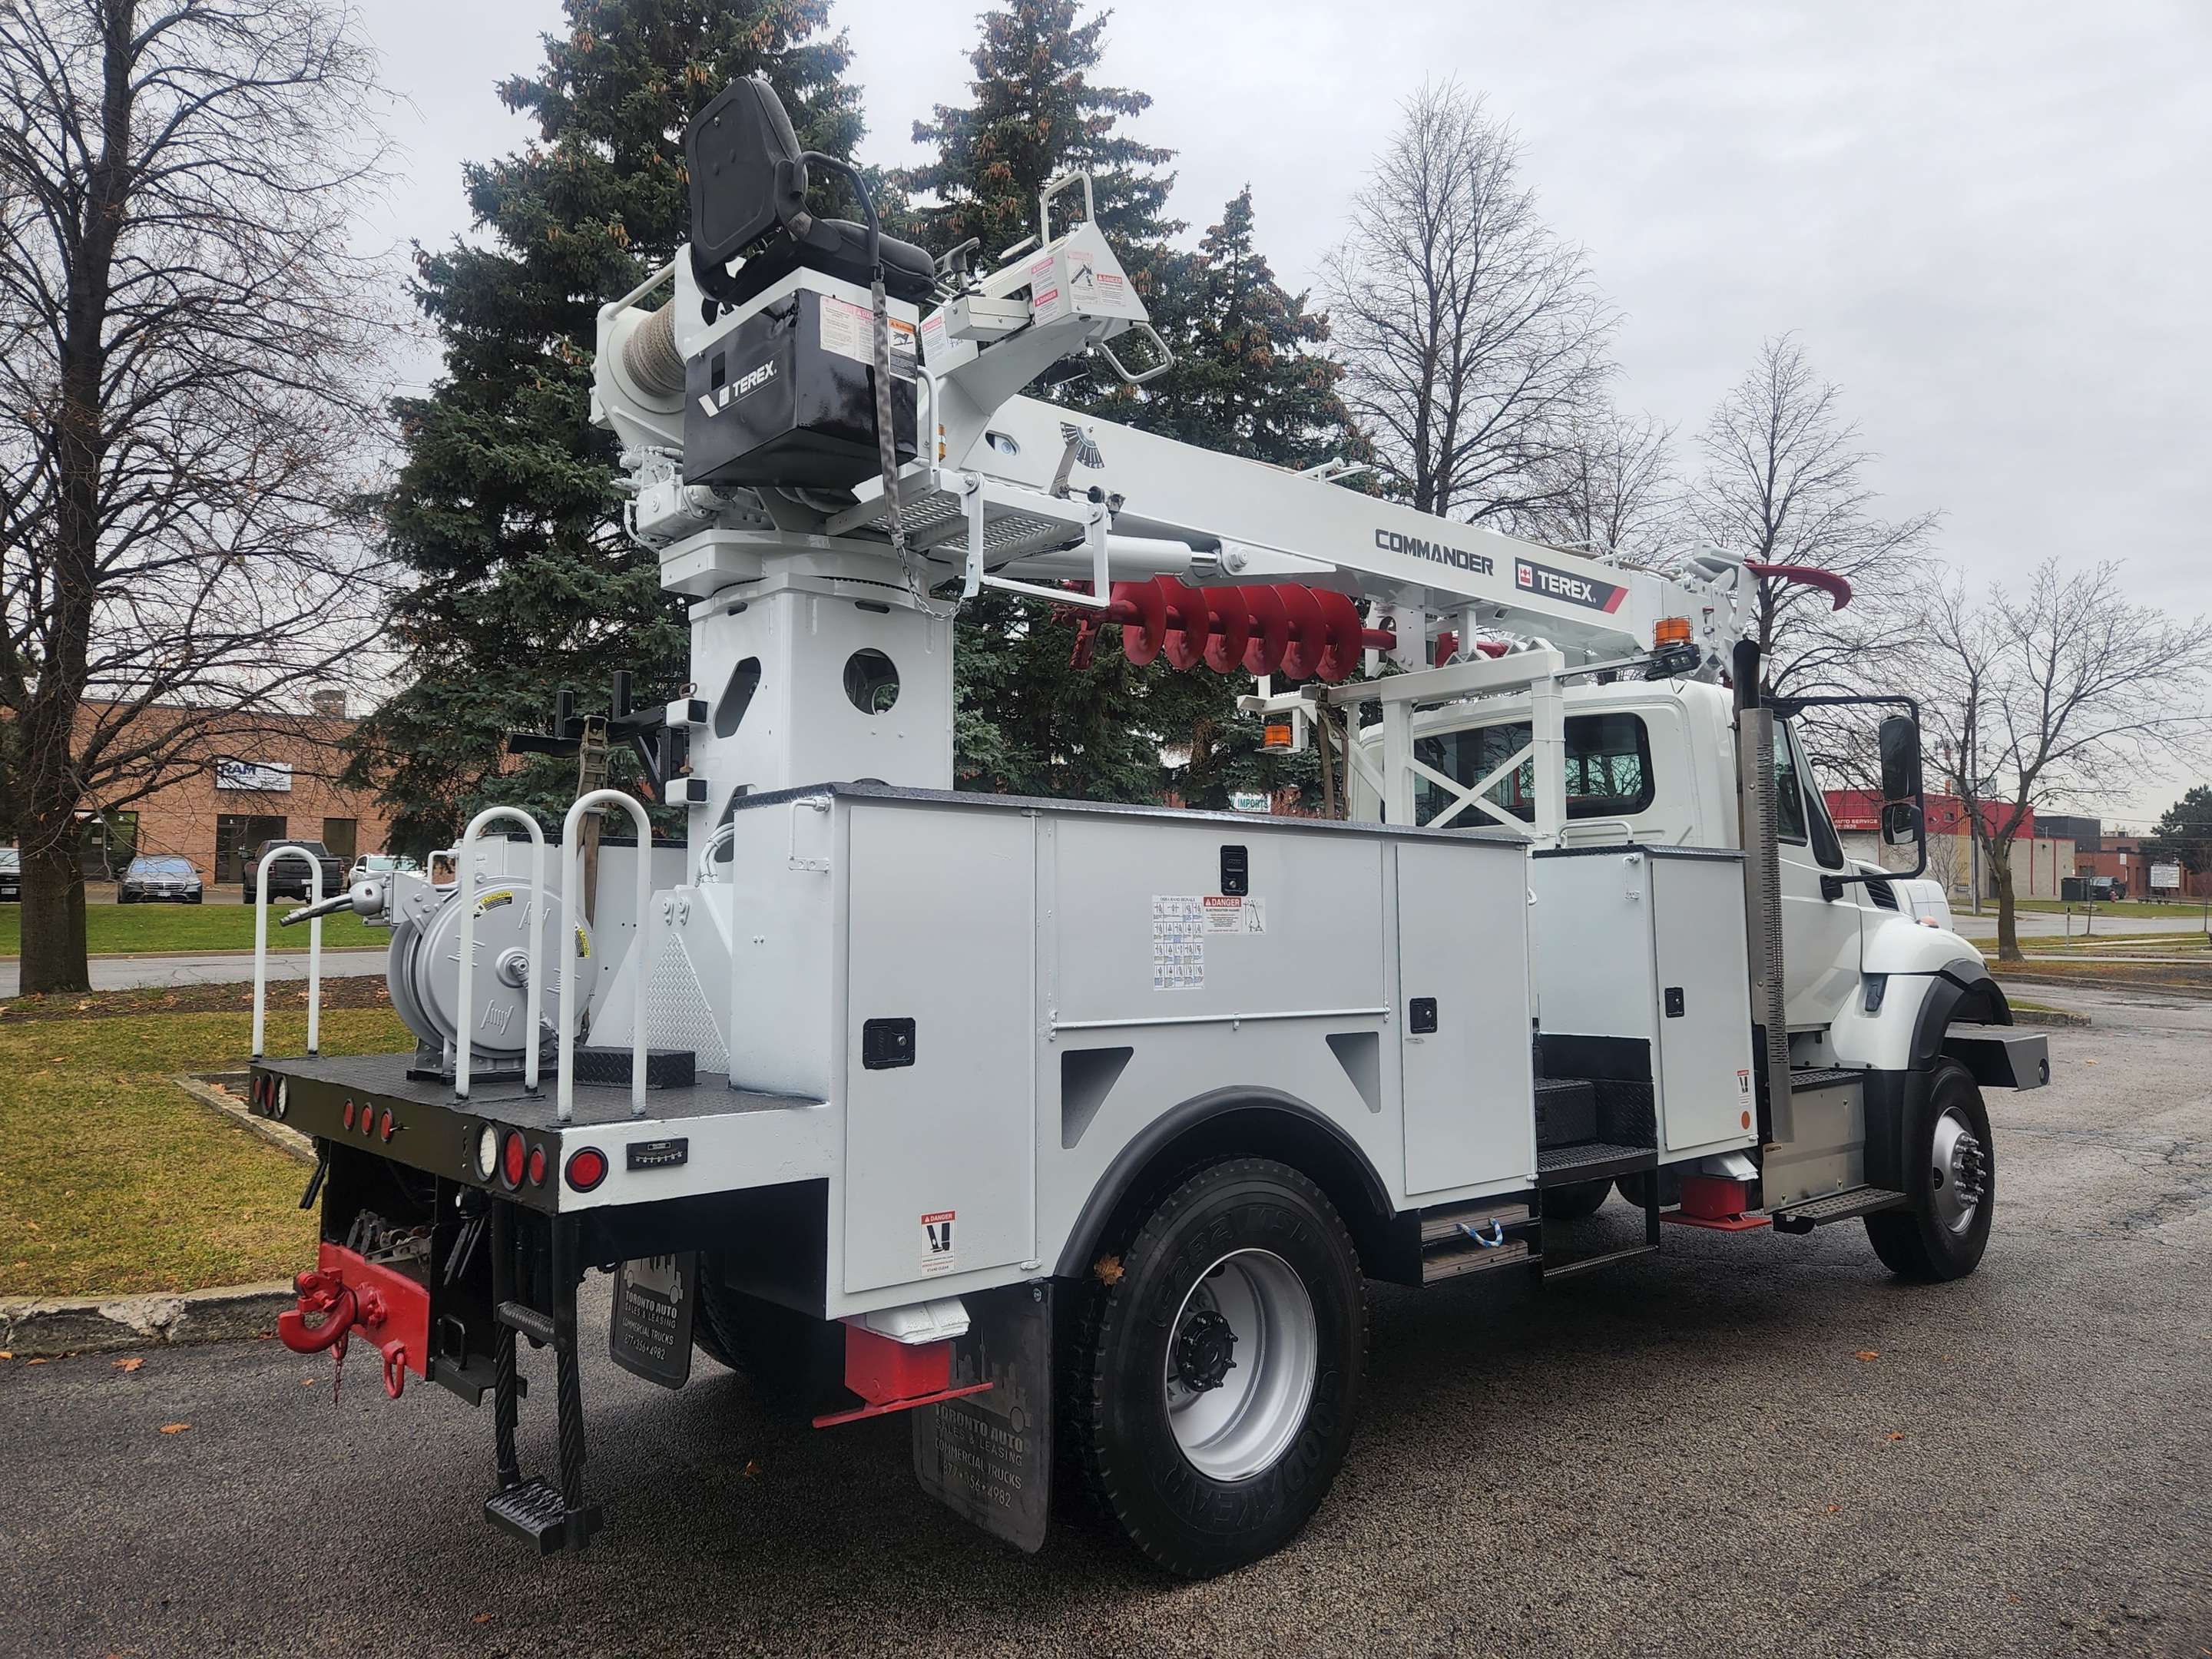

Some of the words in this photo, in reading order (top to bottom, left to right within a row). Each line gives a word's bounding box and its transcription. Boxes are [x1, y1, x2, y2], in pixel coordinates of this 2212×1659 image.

[732, 359, 774, 397] TEREX
[1375, 528, 1494, 577] COMMANDER
[1537, 570, 1593, 603] TEREX
[1237, 798, 1268, 809] IMPORTS
[1211, 898, 1240, 906] DANGER
[930, 1213, 953, 1222] DANGER
[626, 1290, 655, 1311] TORONTO
[655, 1303, 677, 1319] AUTO
[622, 1315, 650, 1338] COMMERCIAL
[651, 1329, 674, 1346] TRUCKS
[647, 1313, 676, 1329] LEASING
[935, 1403, 988, 1437] TORONTO
[991, 1427, 1023, 1453] AUTO
[935, 1418, 965, 1439] SALES
[979, 1437, 1022, 1467] LEASING
[935, 1437, 985, 1472] COMMERCIAL
[988, 1462, 1022, 1489] TRUCKS
